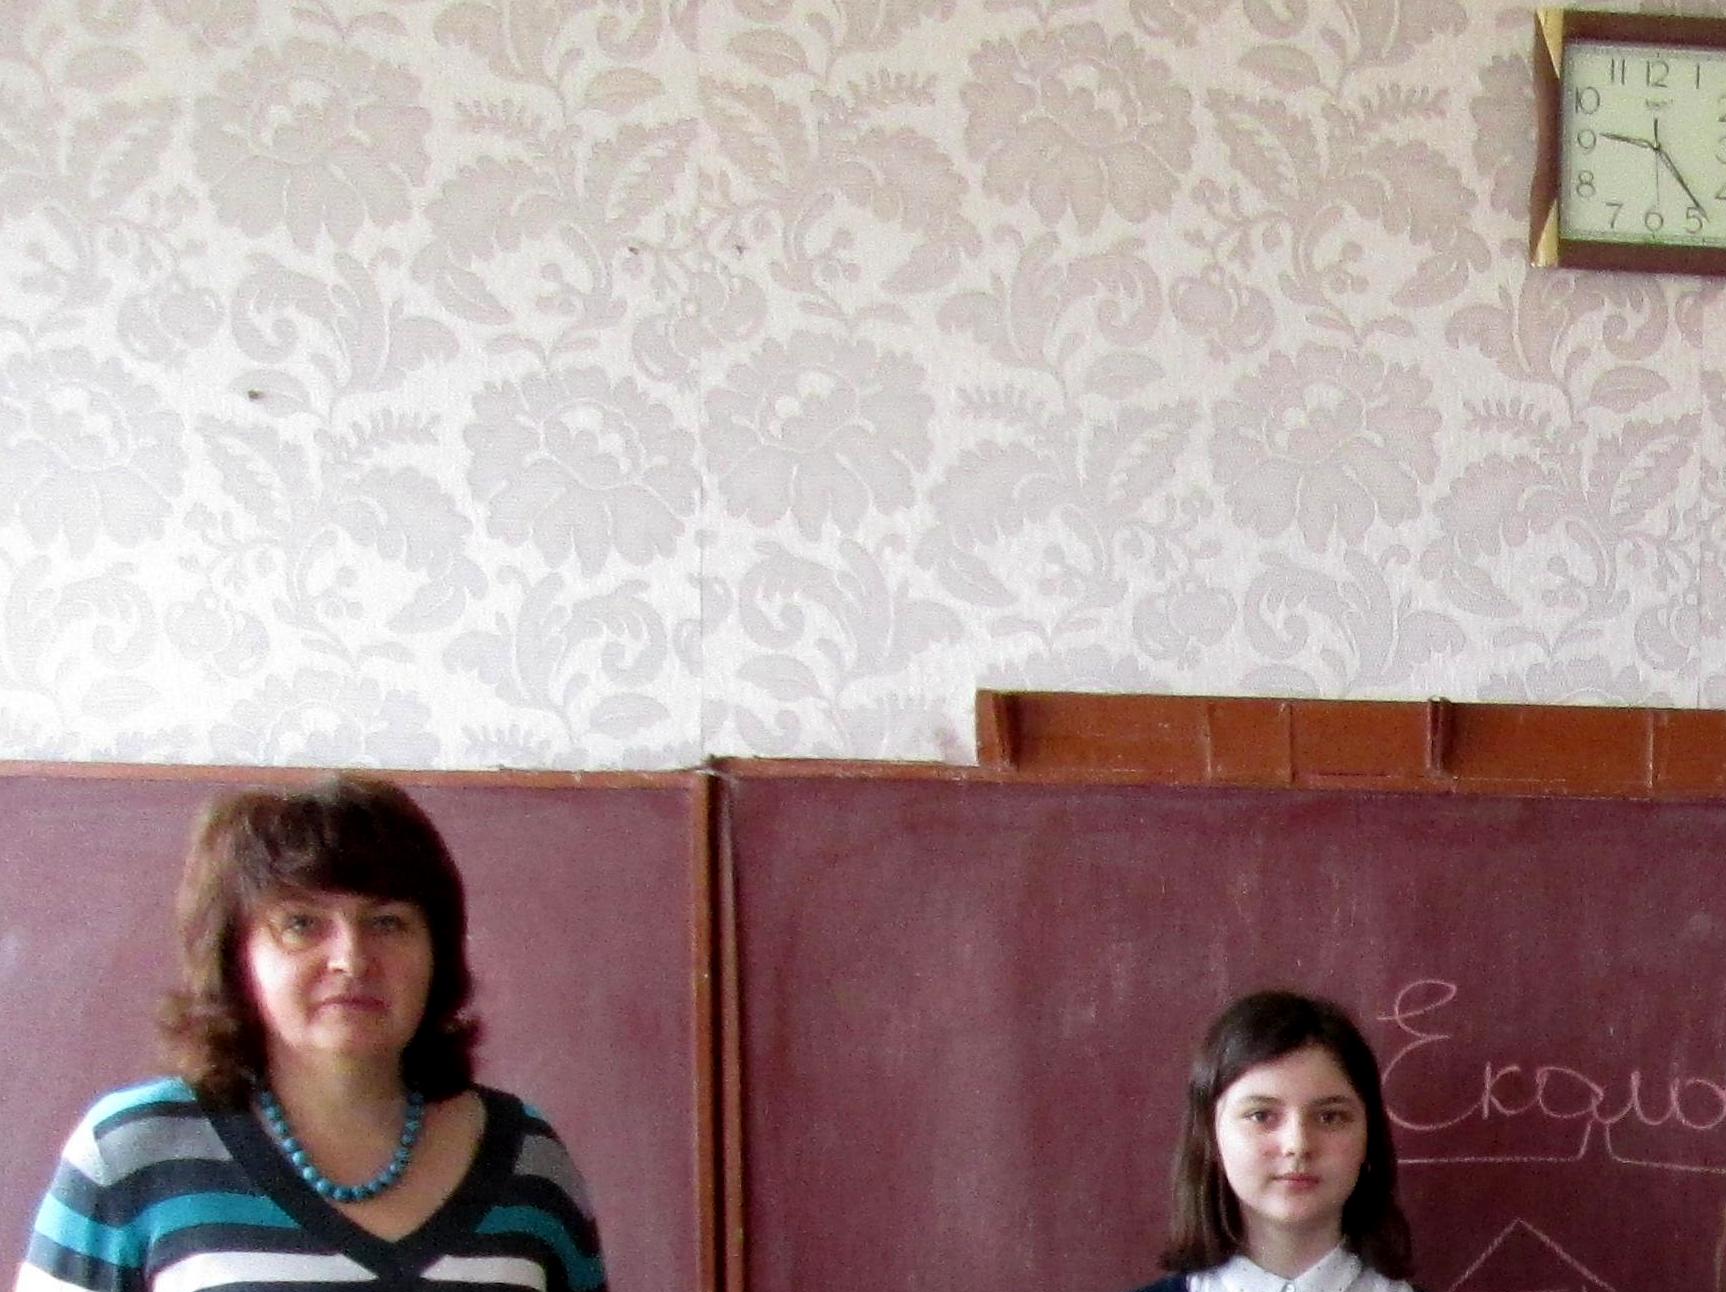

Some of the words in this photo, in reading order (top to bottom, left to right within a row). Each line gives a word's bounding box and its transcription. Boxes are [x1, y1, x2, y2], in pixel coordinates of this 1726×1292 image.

[1610, 58, 1626, 86] 11
[1645, 60, 1670, 88] 12
[1694, 64, 1701, 90] 1
[1574, 86, 1601, 115] 10
[1577, 128, 1597, 156] 9
[1576, 169, 1597, 199] 8
[1605, 202, 1624, 229] 7
[1644, 206, 1664, 232] 6
[1685, 206, 1704, 234] 5
